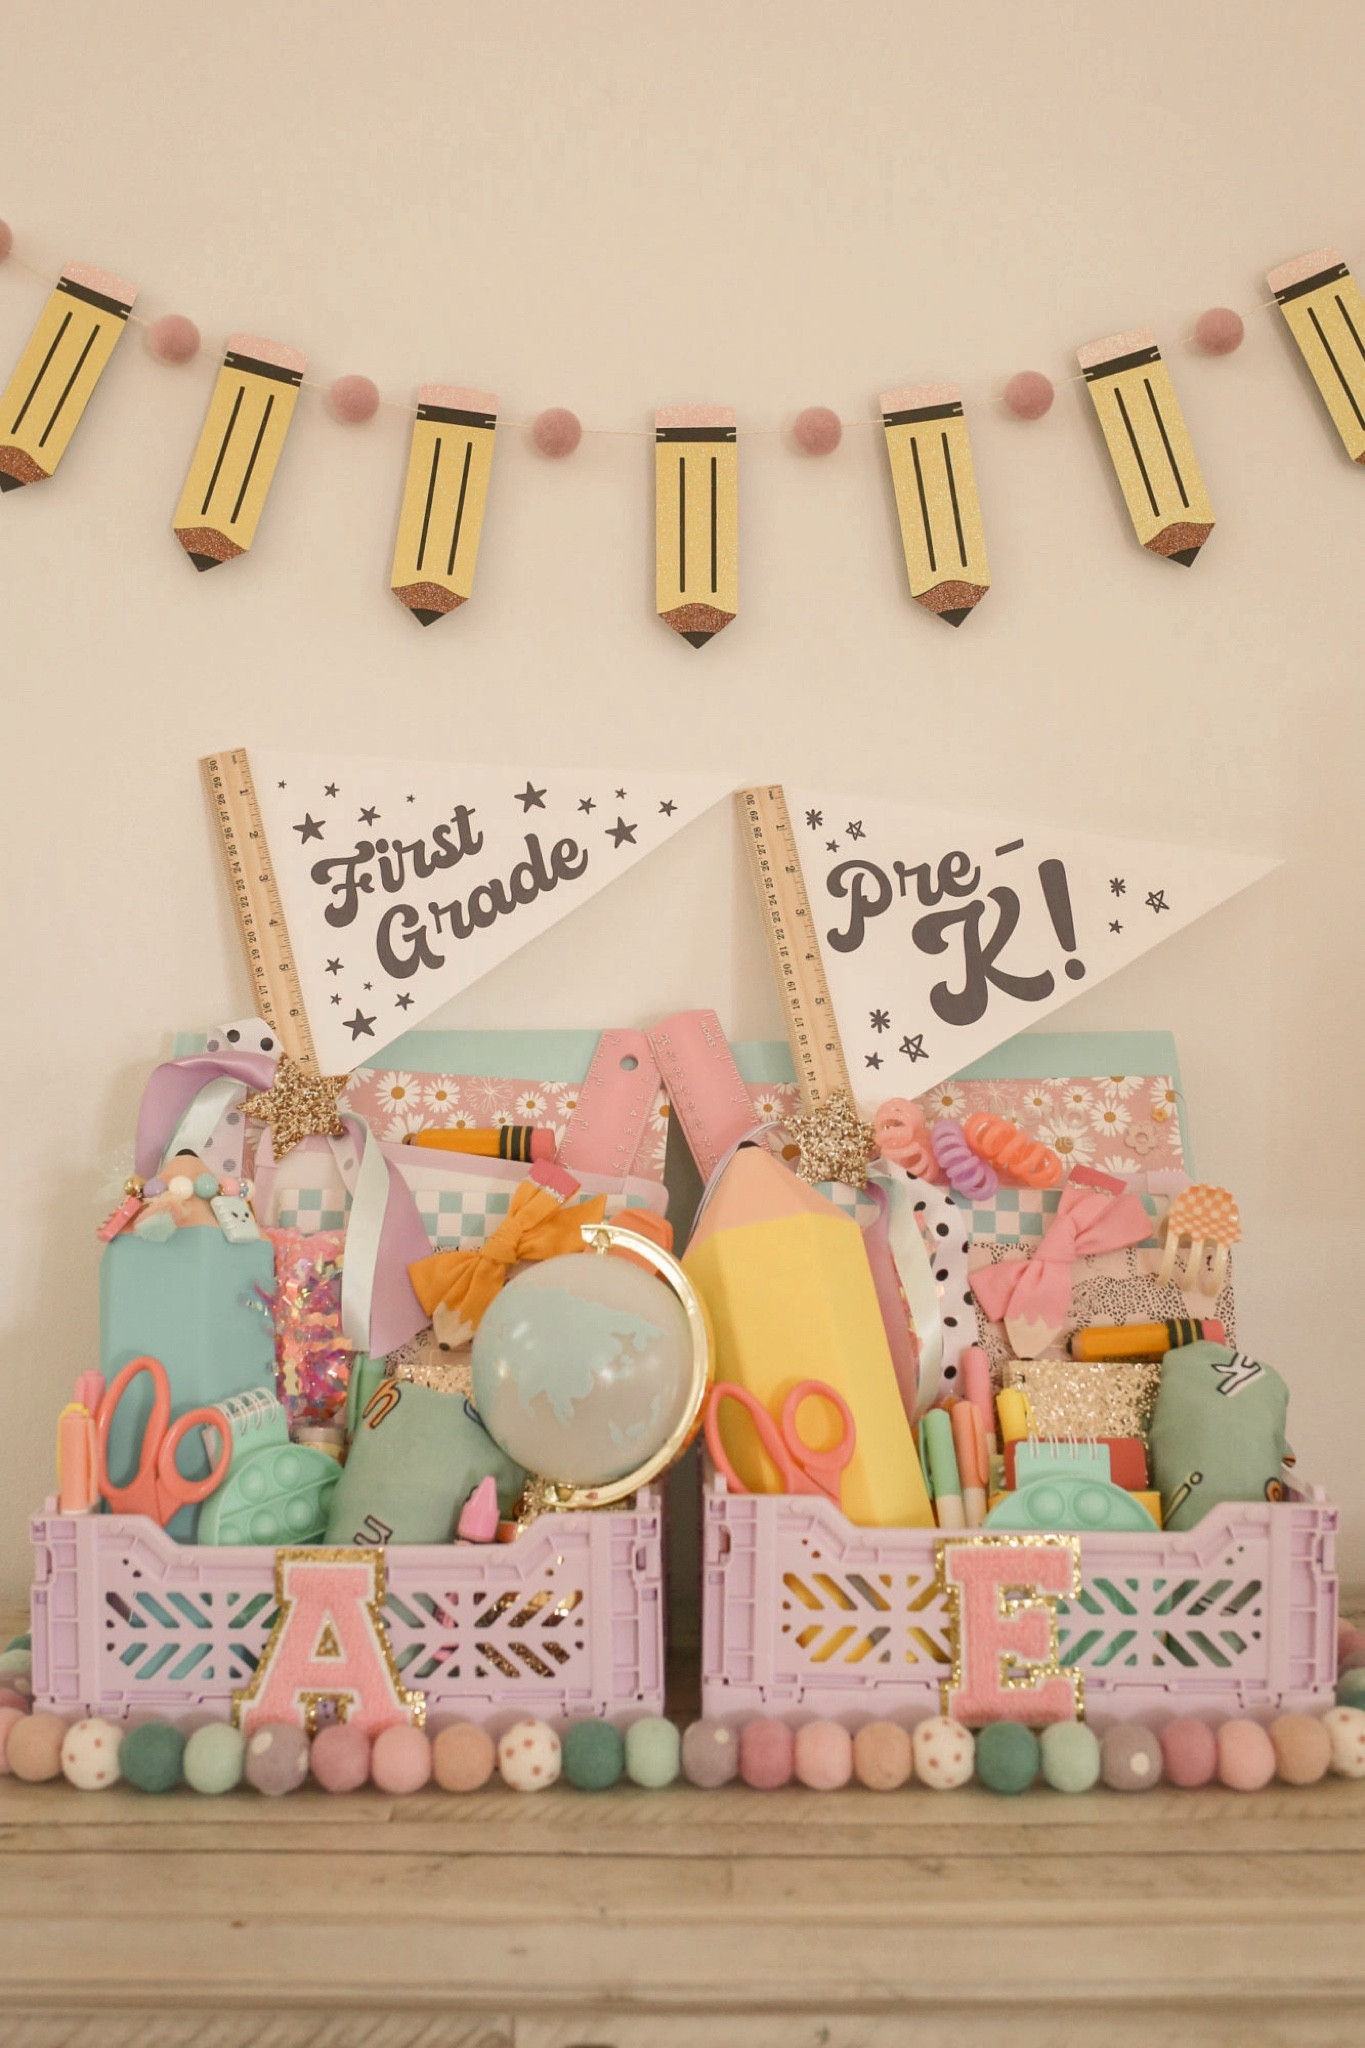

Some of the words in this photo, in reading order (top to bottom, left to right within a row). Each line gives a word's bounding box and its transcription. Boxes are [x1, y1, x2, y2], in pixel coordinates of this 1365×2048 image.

[210, 760, 218, 771] 30
[213, 777, 222, 788] 29
[217, 794, 226, 805] 28
[746, 794, 755, 805] 30
[221, 811, 229, 822] 27
[750, 811, 759, 821] 29
[224, 827, 233, 839] 26
[754, 827, 762, 838] 28
[228, 844, 237, 856] 25
[757, 844, 766, 855] 27
[232, 862, 241, 873] 24
[311, 804, 484, 929] First
[760, 860, 770, 872] 26
[236, 879, 245, 890] 23
[764, 878, 773, 888] 25
[240, 896, 249, 907] 22
[768, 894, 777, 906] 24
[376, 833, 589, 980] Grade
[244, 913, 252, 925] 21
[772, 911, 781, 923] 23
[248, 932, 256, 943] 20
[775, 929, 785, 940] 22
[911, 858, 1086, 1027] K!
[251, 949, 260, 960] 19
[779, 946, 789, 956] 21
[255, 966, 264, 977] 18
[783, 964, 793, 975] 20
[259, 985, 268, 994] 17
[787, 981, 796, 992] 19
[263, 1002, 272, 1013] 16
[791, 998, 800, 1009] 18
[795, 1018, 804, 1027] 17
[799, 1034, 808, 1046] 16
[802, 1053, 812, 1063] 15
[807, 1071, 816, 1081] 14
[811, 1089, 820, 1100] 13
[934, 1534, 1085, 1727] E
[231, 1548, 426, 1733] A
